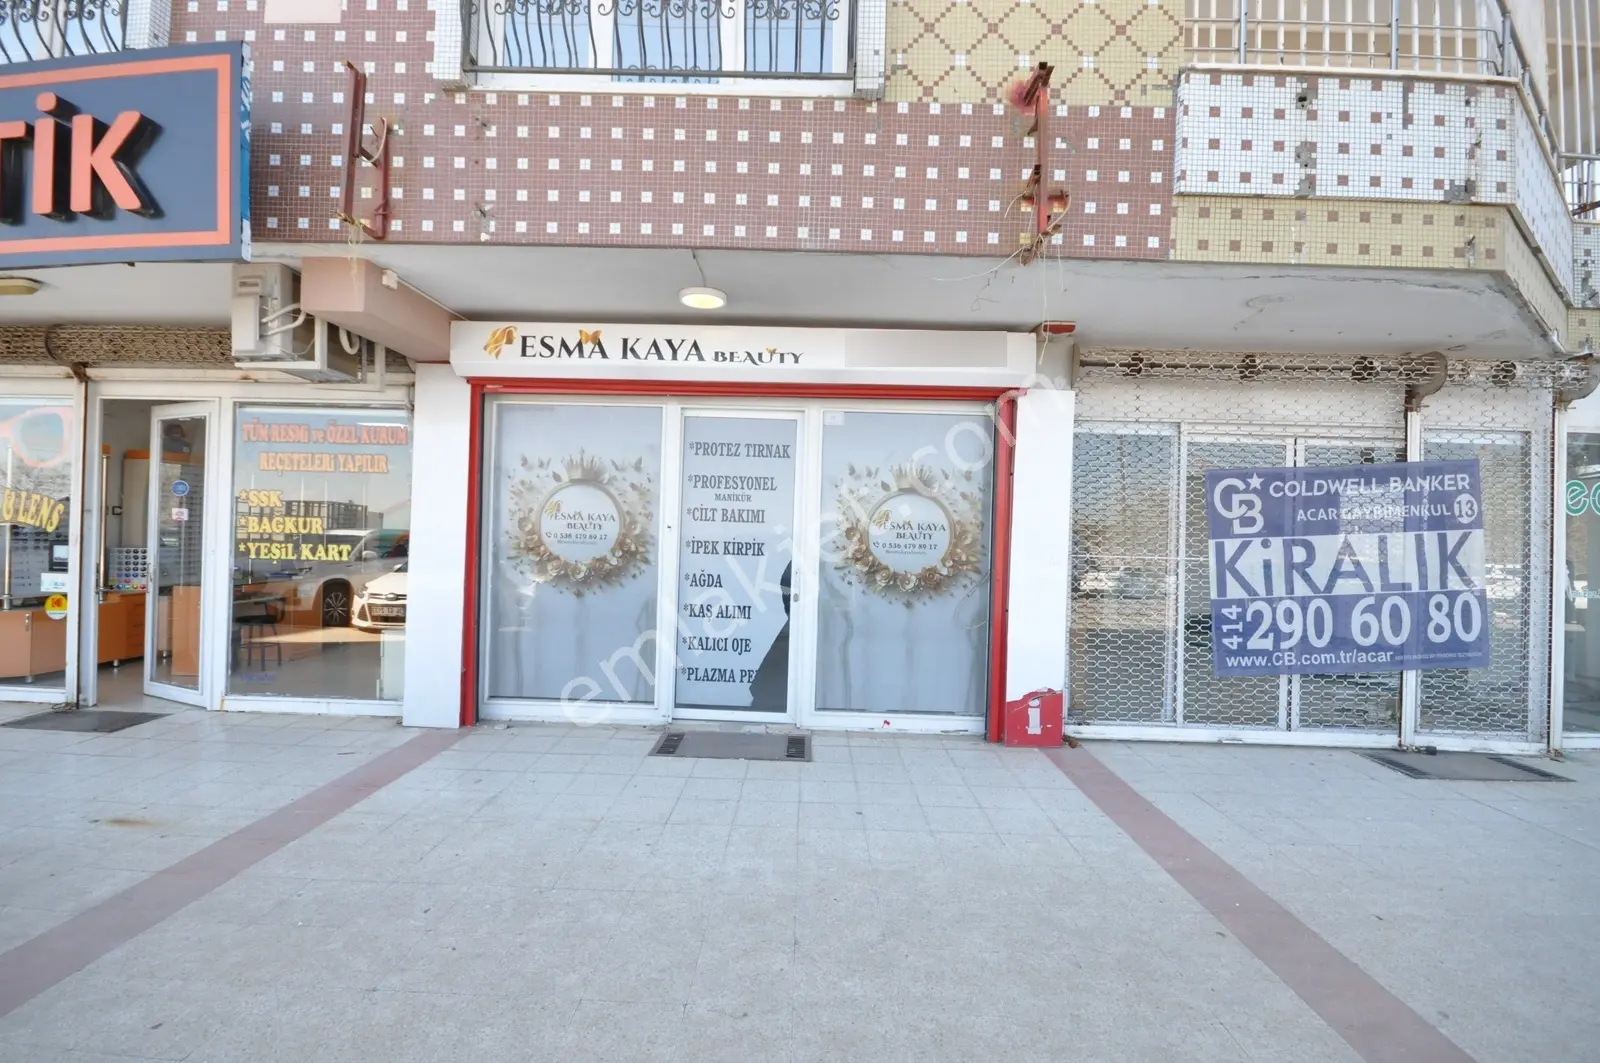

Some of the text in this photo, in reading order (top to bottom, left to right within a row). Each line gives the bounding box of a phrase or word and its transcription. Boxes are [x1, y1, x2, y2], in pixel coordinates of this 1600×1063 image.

[520, 335, 804, 366] ESMA KAYA BEAUTY
[327, 419, 358, 444] ÖZEL
[361, 425, 408, 445] KURUM
[745, 443, 791, 459] TIRNAK
[338, 454, 389, 473] YAPILIR
[1269, 474, 1470, 498] COLDWELL BANKER
[17, 491, 64, 533] LENS
[554, 512, 616, 522] ESMA KAYA
[720, 508, 765, 524] BAKIMI
[1297, 508, 1337, 522] ACAR
[567, 522, 603, 531] BEAUTY
[884, 522, 946, 532] ESMA KAYA
[896, 532, 934, 541] BEAUTY
[300, 544, 352, 561] KART
[723, 537, 765, 556] KİRPİK
[716, 605, 751, 620] ALIMI
[1221, 592, 1481, 651] 414 290 60 80
[731, 638, 751, 655] OJE
[1226, 649, 1393, 668] www.CB.com.tr/acar
[739, 669, 758, 684] PE
